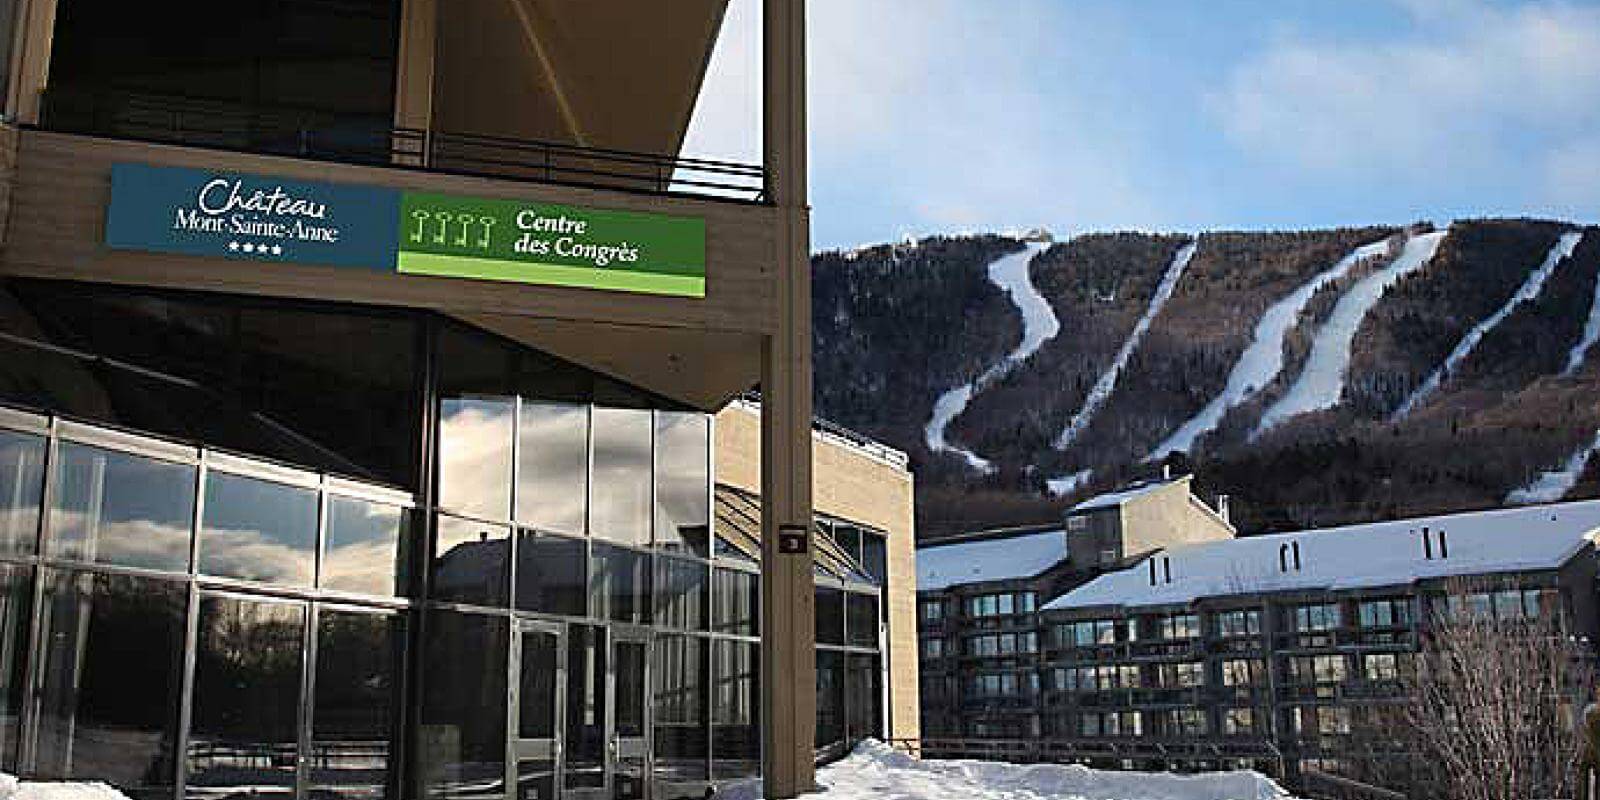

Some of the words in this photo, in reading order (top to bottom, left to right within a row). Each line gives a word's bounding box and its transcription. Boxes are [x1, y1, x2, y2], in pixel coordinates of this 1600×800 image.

[199, 179, 326, 219] Château
[516, 209, 588, 234] Centre
[514, 233, 549, 254] des
[555, 237, 639, 266] Congrès
